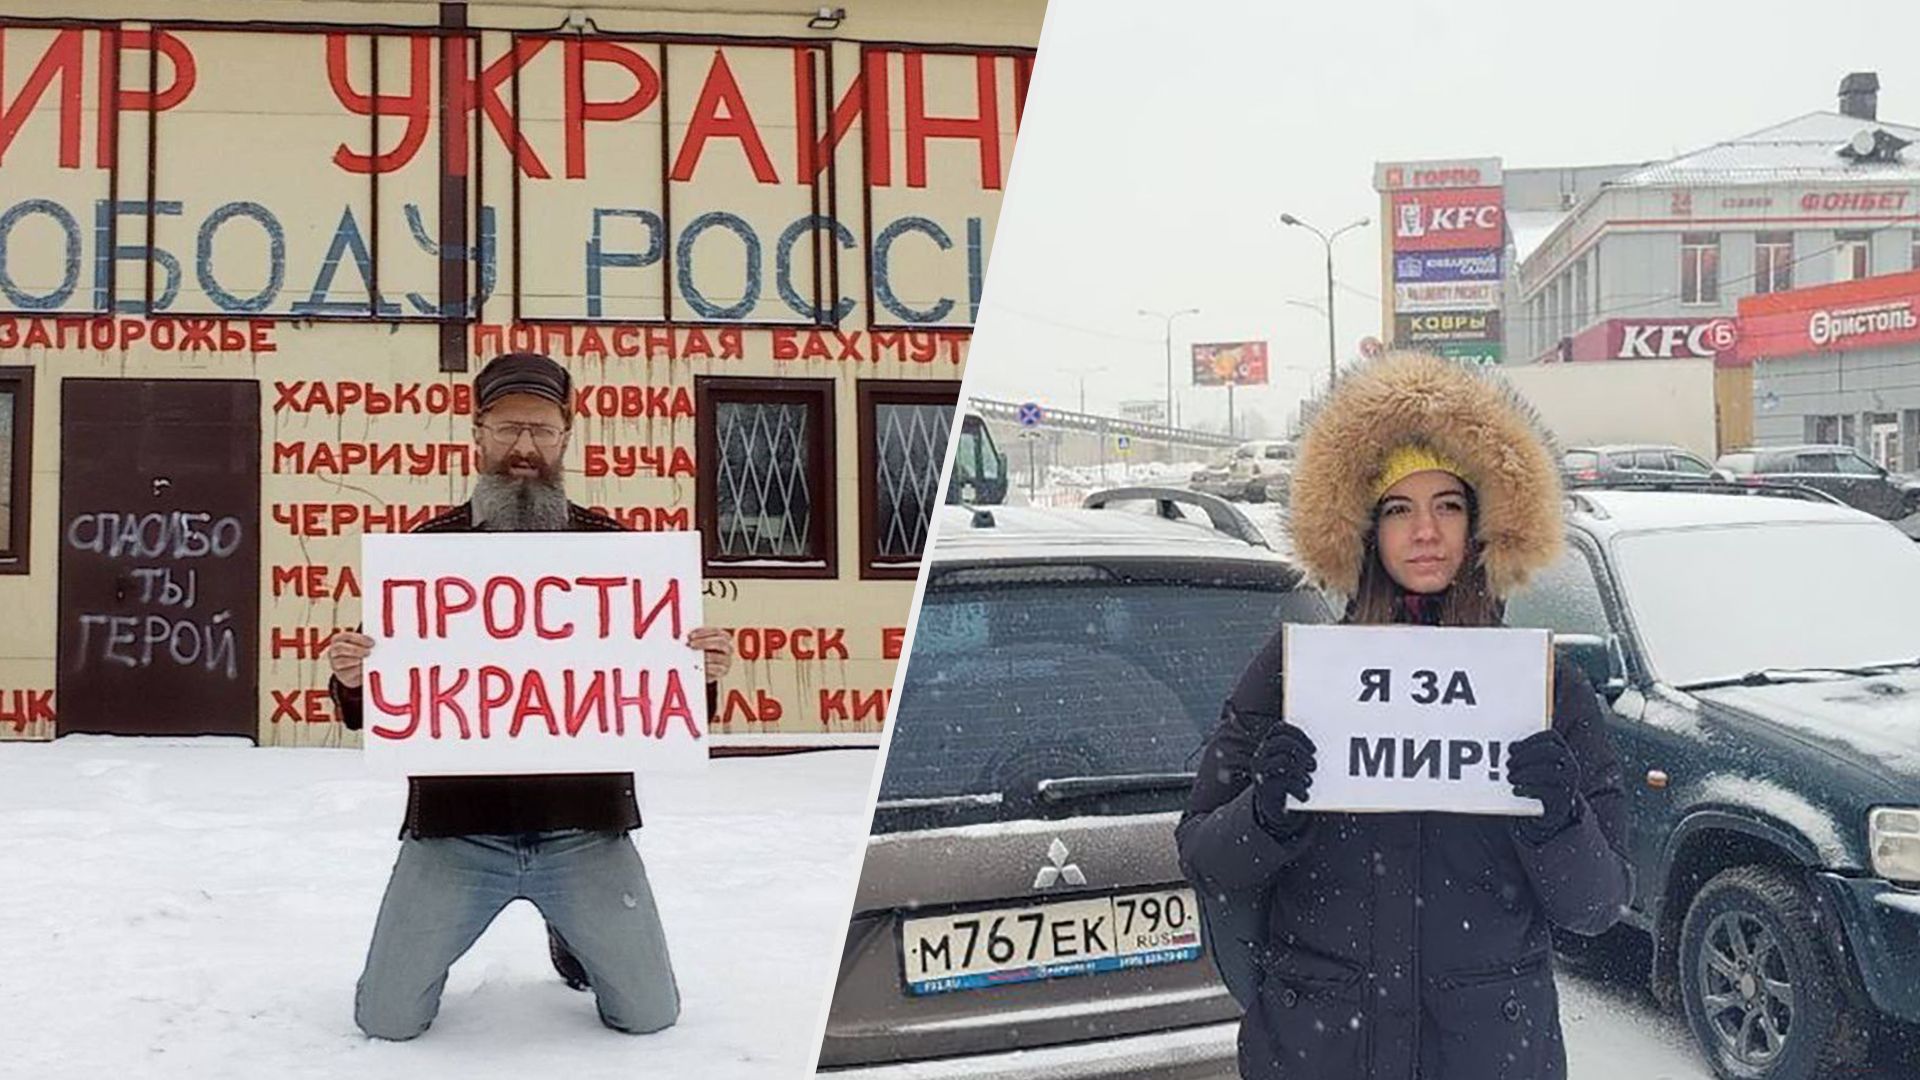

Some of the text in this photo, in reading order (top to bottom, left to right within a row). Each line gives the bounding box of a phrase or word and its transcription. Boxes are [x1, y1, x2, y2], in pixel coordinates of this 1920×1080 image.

[1429, 206, 1498, 230] KFC
[1801, 191, 1908, 211] ФОНБЕТ
[1411, 316, 1486, 332] КОВРЫ
[1618, 324, 1718, 359] KFC
[0, 320, 969, 366] ЗАПОРОЖЬЕ ПОПАСНАЯ БАХМУТ
[273, 381, 471, 415] ХАРЬКОВ
[272, 443, 696, 478] МАРИУП БУЧА
[130, 567, 197, 608] ТЫ
[381, 576, 683, 640] ПРОСТИ
[77, 609, 238, 680] ГЕРОЙ
[271, 627, 355, 660] НИ
[722, 628, 849, 662] ОРСК
[368, 665, 702, 740] УКРАИНА
[1357, 668, 1477, 706] Я ЗА
[271, 690, 341, 723] ХЕ
[711, 688, 783, 724] ЛЬ
[819, 689, 893, 725] КИ
[1348, 736, 1501, 782] МИР!
[1117, 895, 1187, 936] 790
[1136, 933, 1172, 949] RUS
